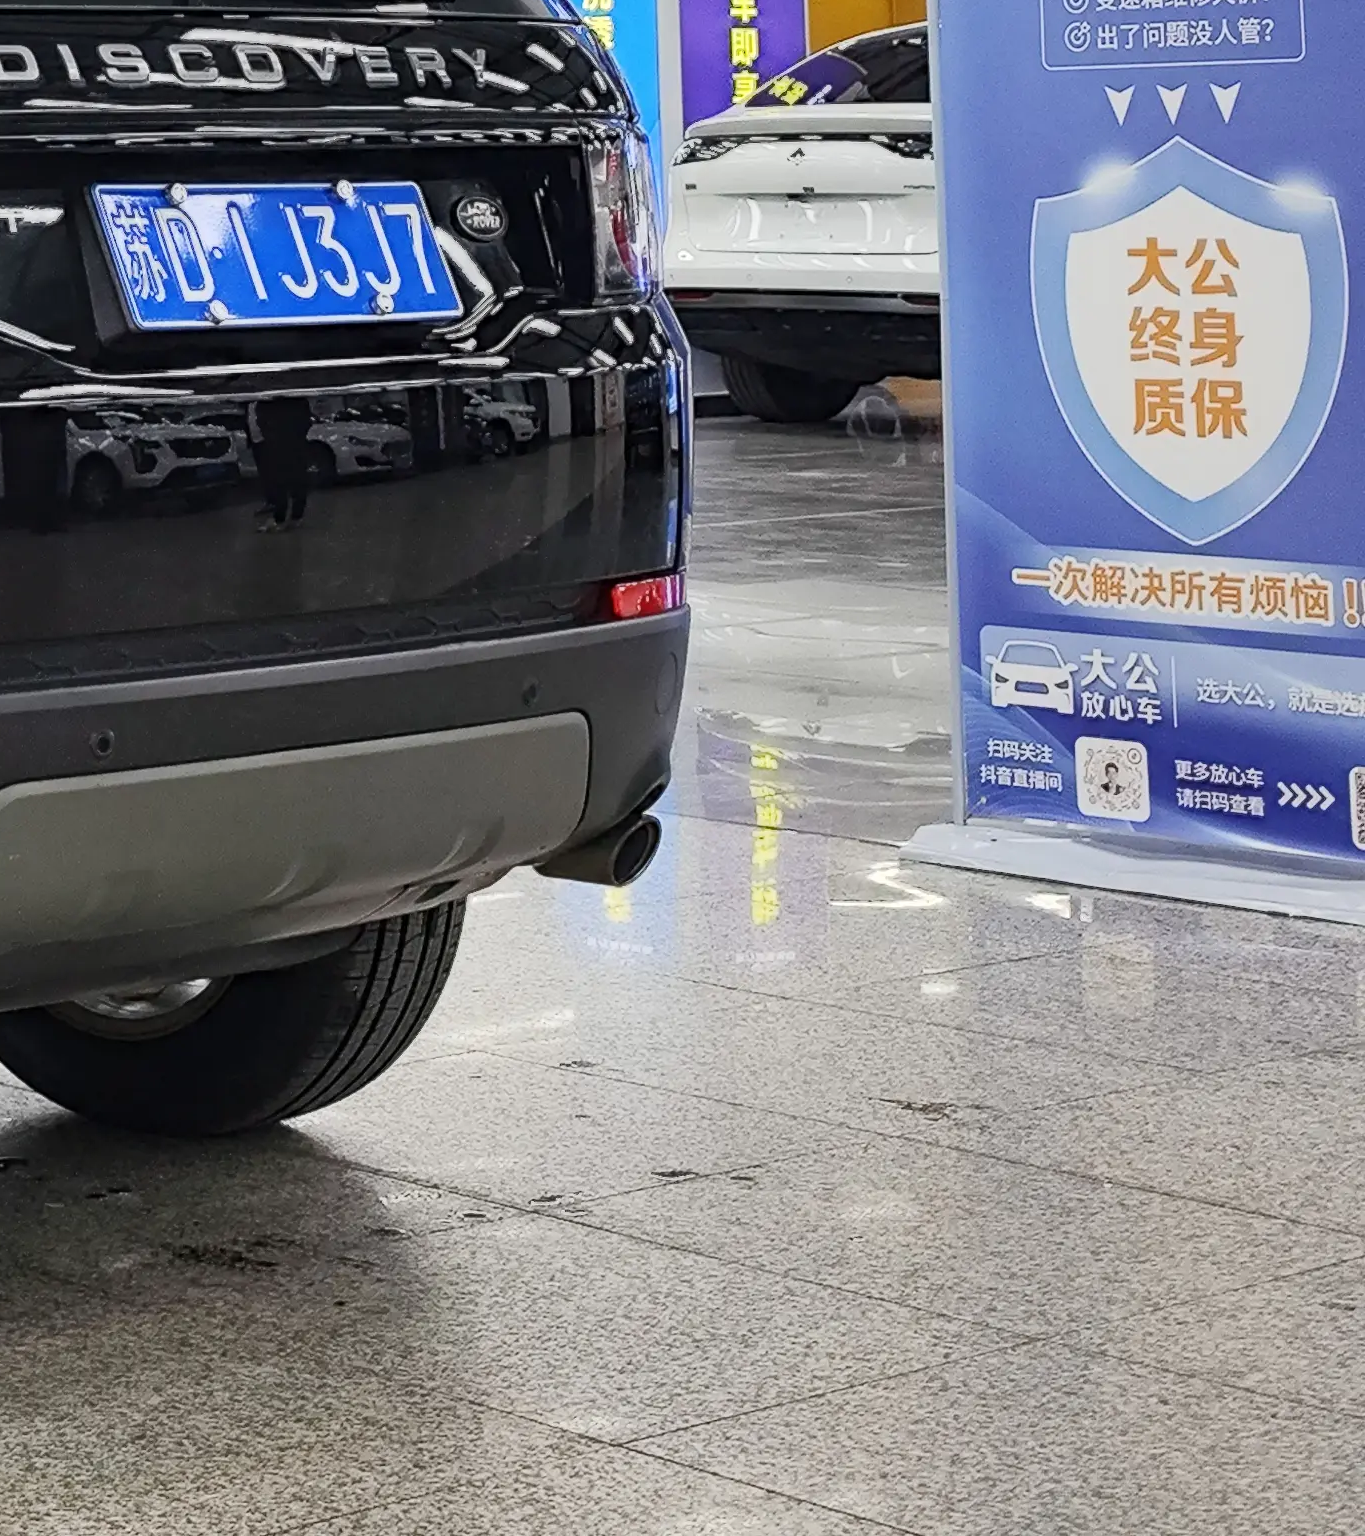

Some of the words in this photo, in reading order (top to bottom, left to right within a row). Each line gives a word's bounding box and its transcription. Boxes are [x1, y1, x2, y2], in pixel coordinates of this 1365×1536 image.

[1096, 17, 1275, 51] 出了问题没人管?
[1127, 237, 1240, 297] 大公
[1128, 306, 1244, 368] 终身
[1133, 378, 1248, 439] 质保
[1080, 648, 1160, 694] 大公
[1080, 691, 1162, 724] 放心车
[1196, 677, 1365, 718] 选大公，就是选
[986, 738, 1053, 764] 扫码关注
[980, 765, 1063, 793] 抖音直播间
[1174, 759, 1265, 789] 更多放心车
[1176, 787, 1265, 816] 请扫码查看
